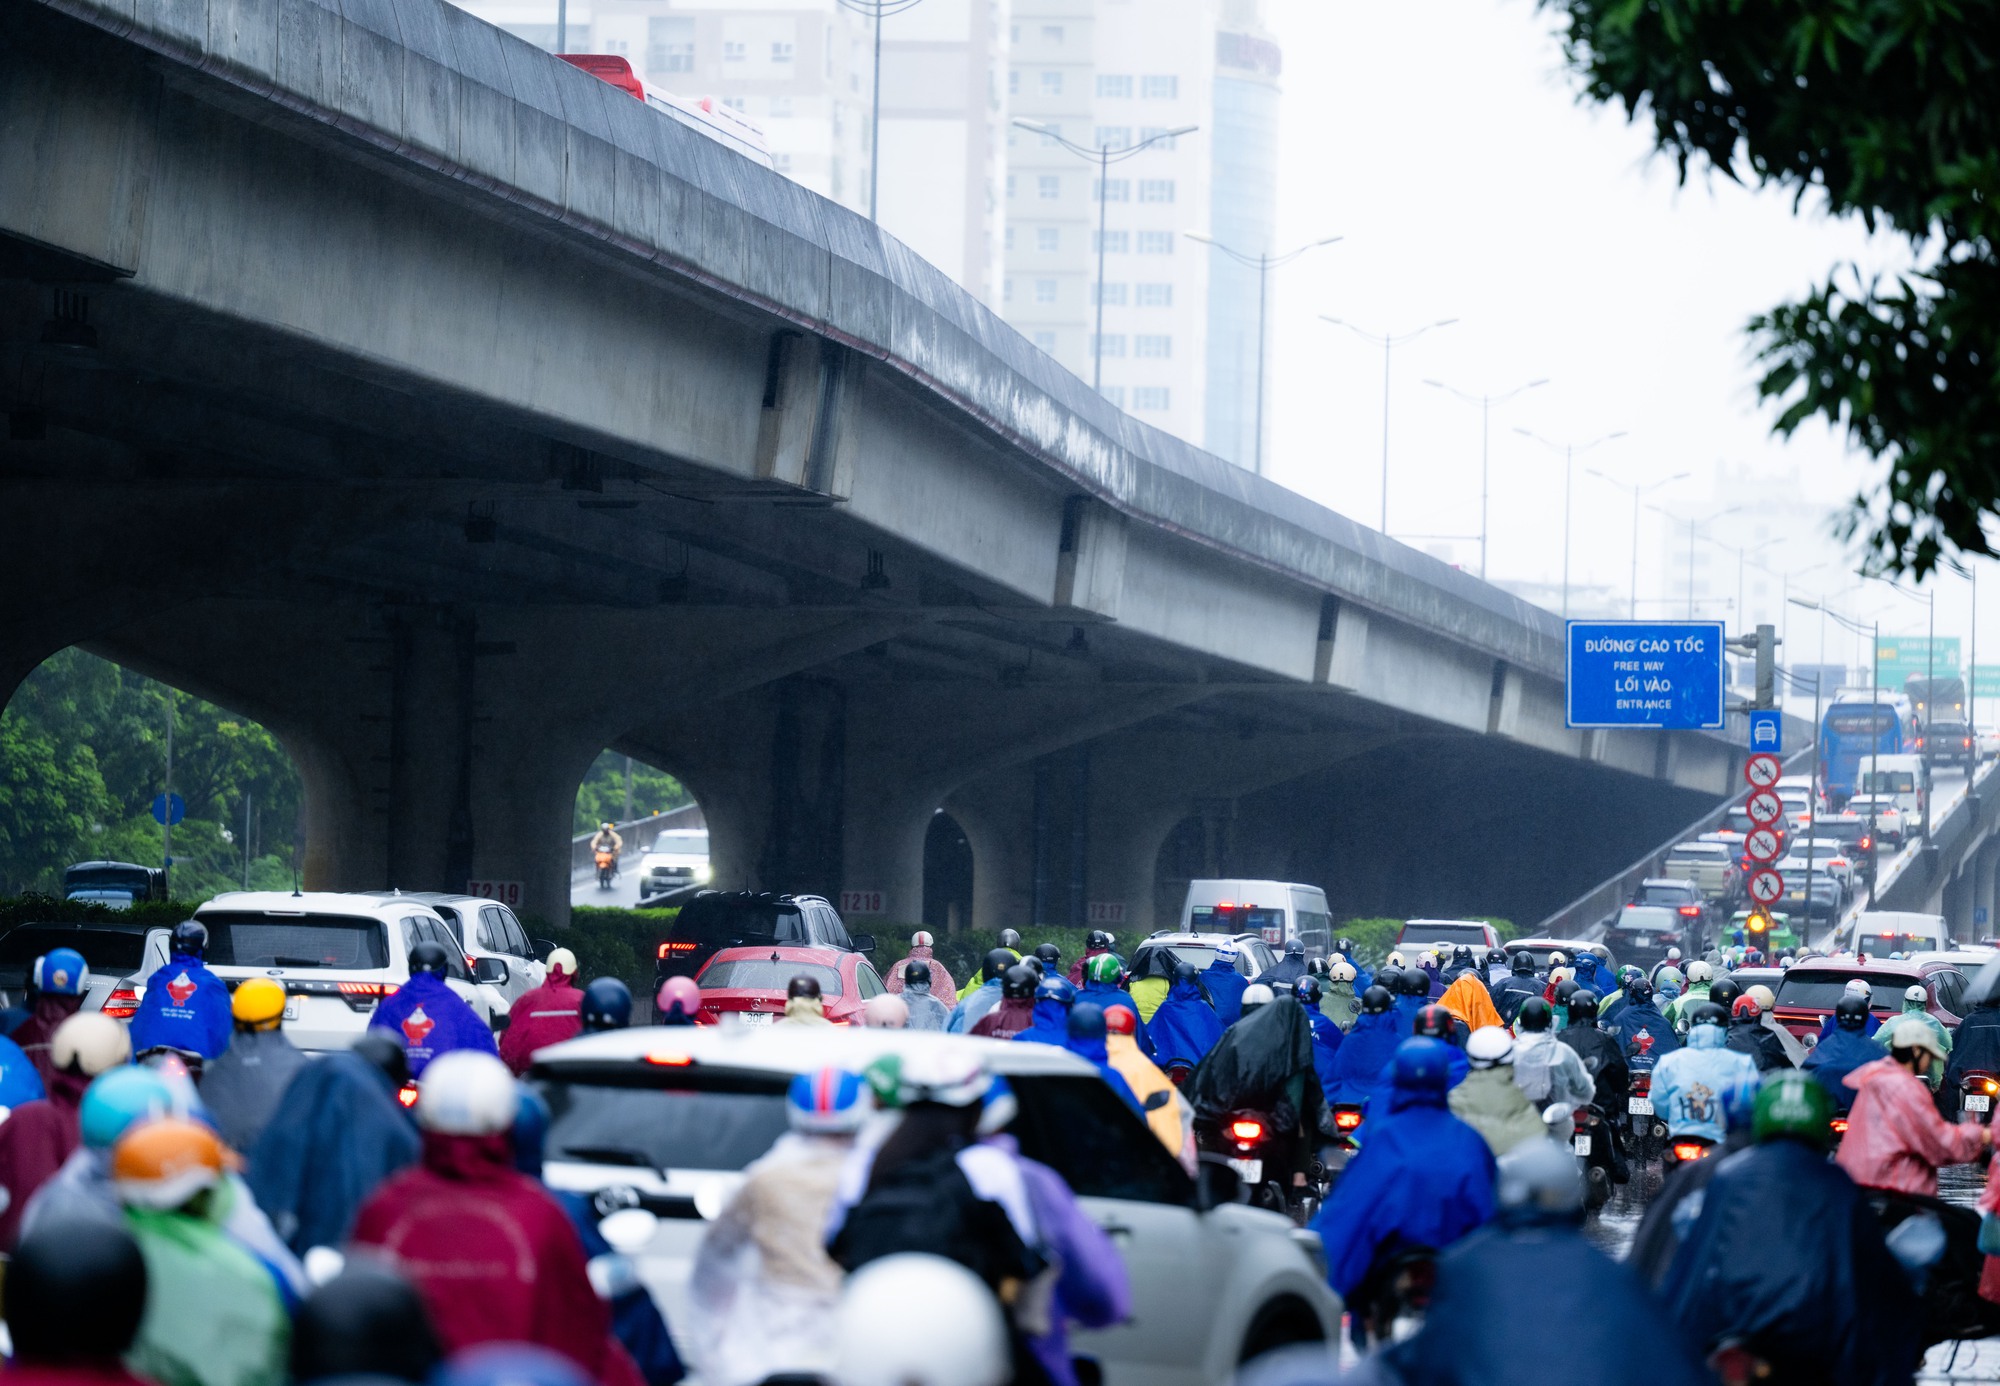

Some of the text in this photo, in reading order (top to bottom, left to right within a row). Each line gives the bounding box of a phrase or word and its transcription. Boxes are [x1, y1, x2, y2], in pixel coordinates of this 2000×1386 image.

[1585, 635, 1705, 653] ĐƯỜNG CAO TỐC
[1614, 661, 1665, 671] FREE WAY
[1615, 675, 1671, 692] LỐI VÀO
[1616, 699, 1672, 710] ENTRANCE
[842, 893, 881, 911] T218
